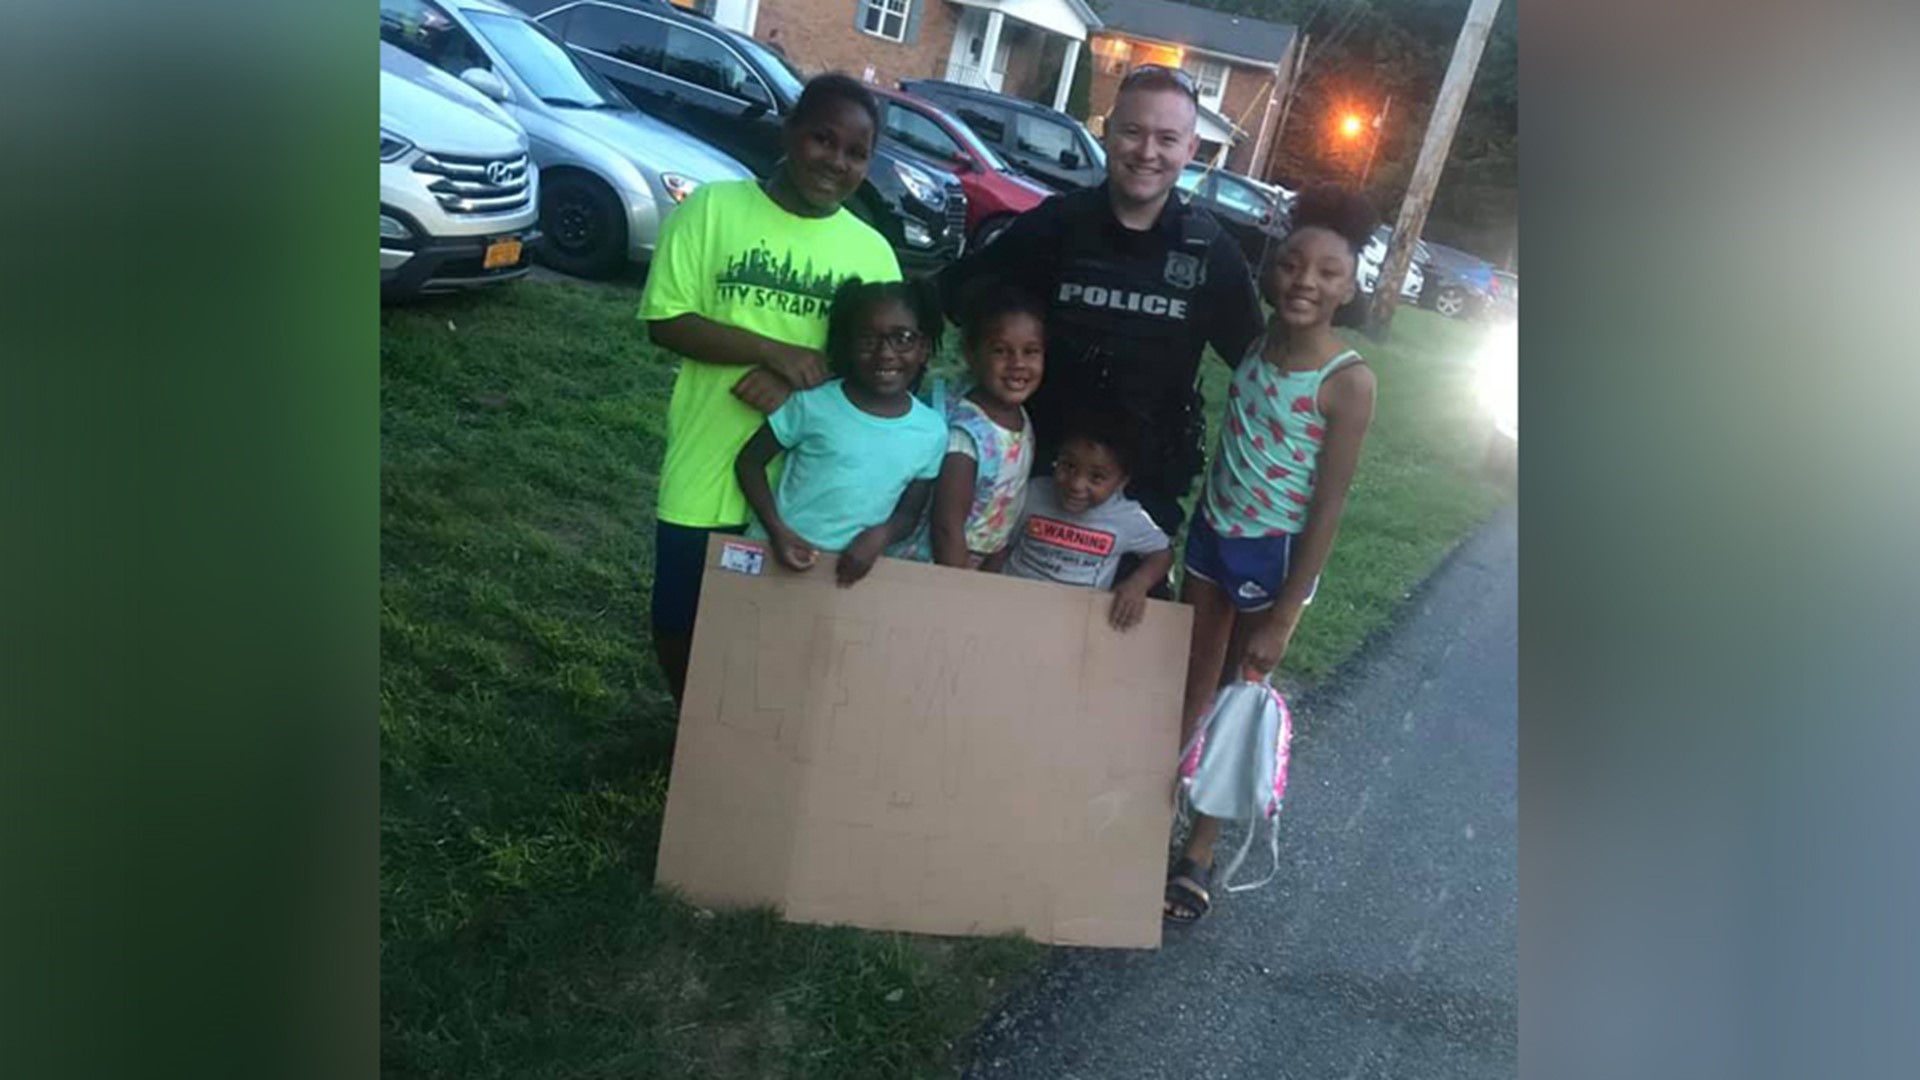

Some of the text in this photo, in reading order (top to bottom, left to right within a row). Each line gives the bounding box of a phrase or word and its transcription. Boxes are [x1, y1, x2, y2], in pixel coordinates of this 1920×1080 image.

[754, 288, 816, 317] SCRAP
[1058, 283, 1188, 320] POLICE
[1043, 523, 1110, 551] WARNING
